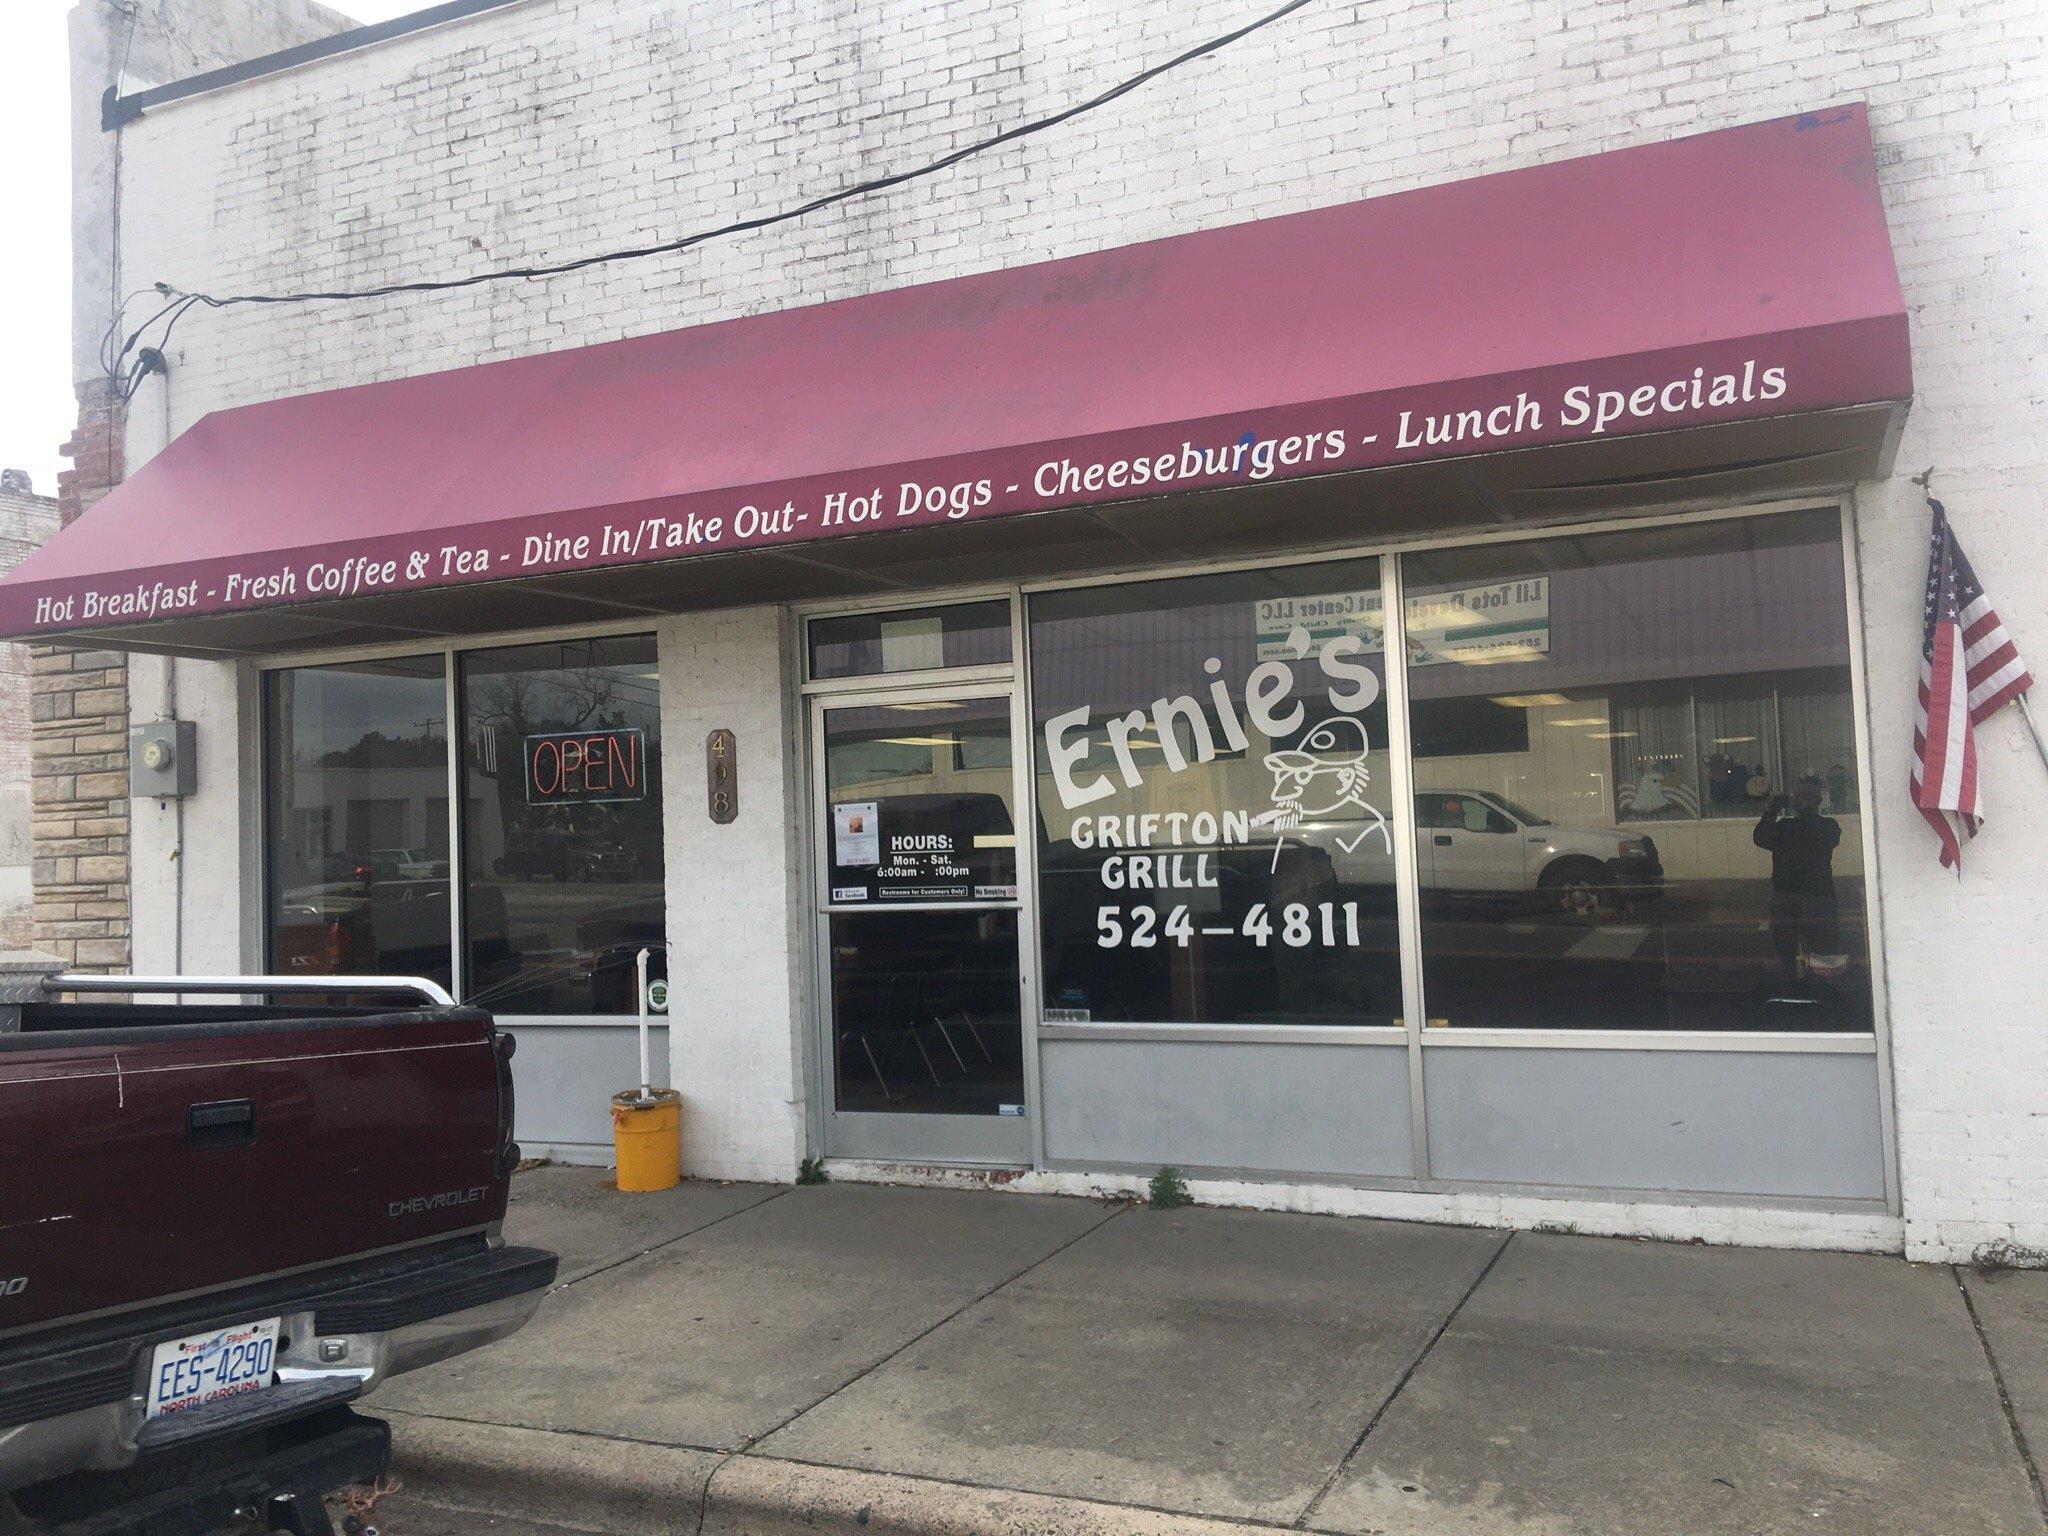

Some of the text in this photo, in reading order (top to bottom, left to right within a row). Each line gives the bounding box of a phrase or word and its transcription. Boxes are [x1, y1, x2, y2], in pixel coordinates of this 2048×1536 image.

[34, 596, 74, 624] Hot
[83, 578, 198, 619] Breakfast
[224, 573, 297, 602] Fresh
[306, 557, 396, 595] Coffee
[405, 552, 427, 578] &
[439, 545, 490, 576] Tea
[521, 530, 590, 567] Dine
[600, 510, 722, 557] In/Take
[821, 487, 882, 526] Hot
[897, 477, 992, 519] Dogs
[1033, 428, 1346, 479] Cheeseburgers
[1396, 393, 1543, 450] Lunch
[1560, 360, 1788, 433] Specials
[1044, 626, 1380, 810] Ernie's
[534, 735, 636, 794] OPEN
[712, 735, 730, 814] 498
[891, 834, 953, 850] HOURS:
[1070, 810, 1249, 849] GRIFTON
[877, 867, 917, 877] 6:00am
[893, 856, 919, 866] Mon.
[930, 855, 952, 865] Sat.
[1101, 854, 1218, 889] GRILL
[920, 887, 950, 896] Customers
[975, 887, 1007, 897] No Smoking
[1096, 902, 1360, 948] 524-4811
[388, 1185, 490, 1217] CHEVROLET
[184, 1341, 207, 1353] First
[158, 1338, 273, 1402] EES-4290
[204, 1379, 260, 1402] CAROLINA
